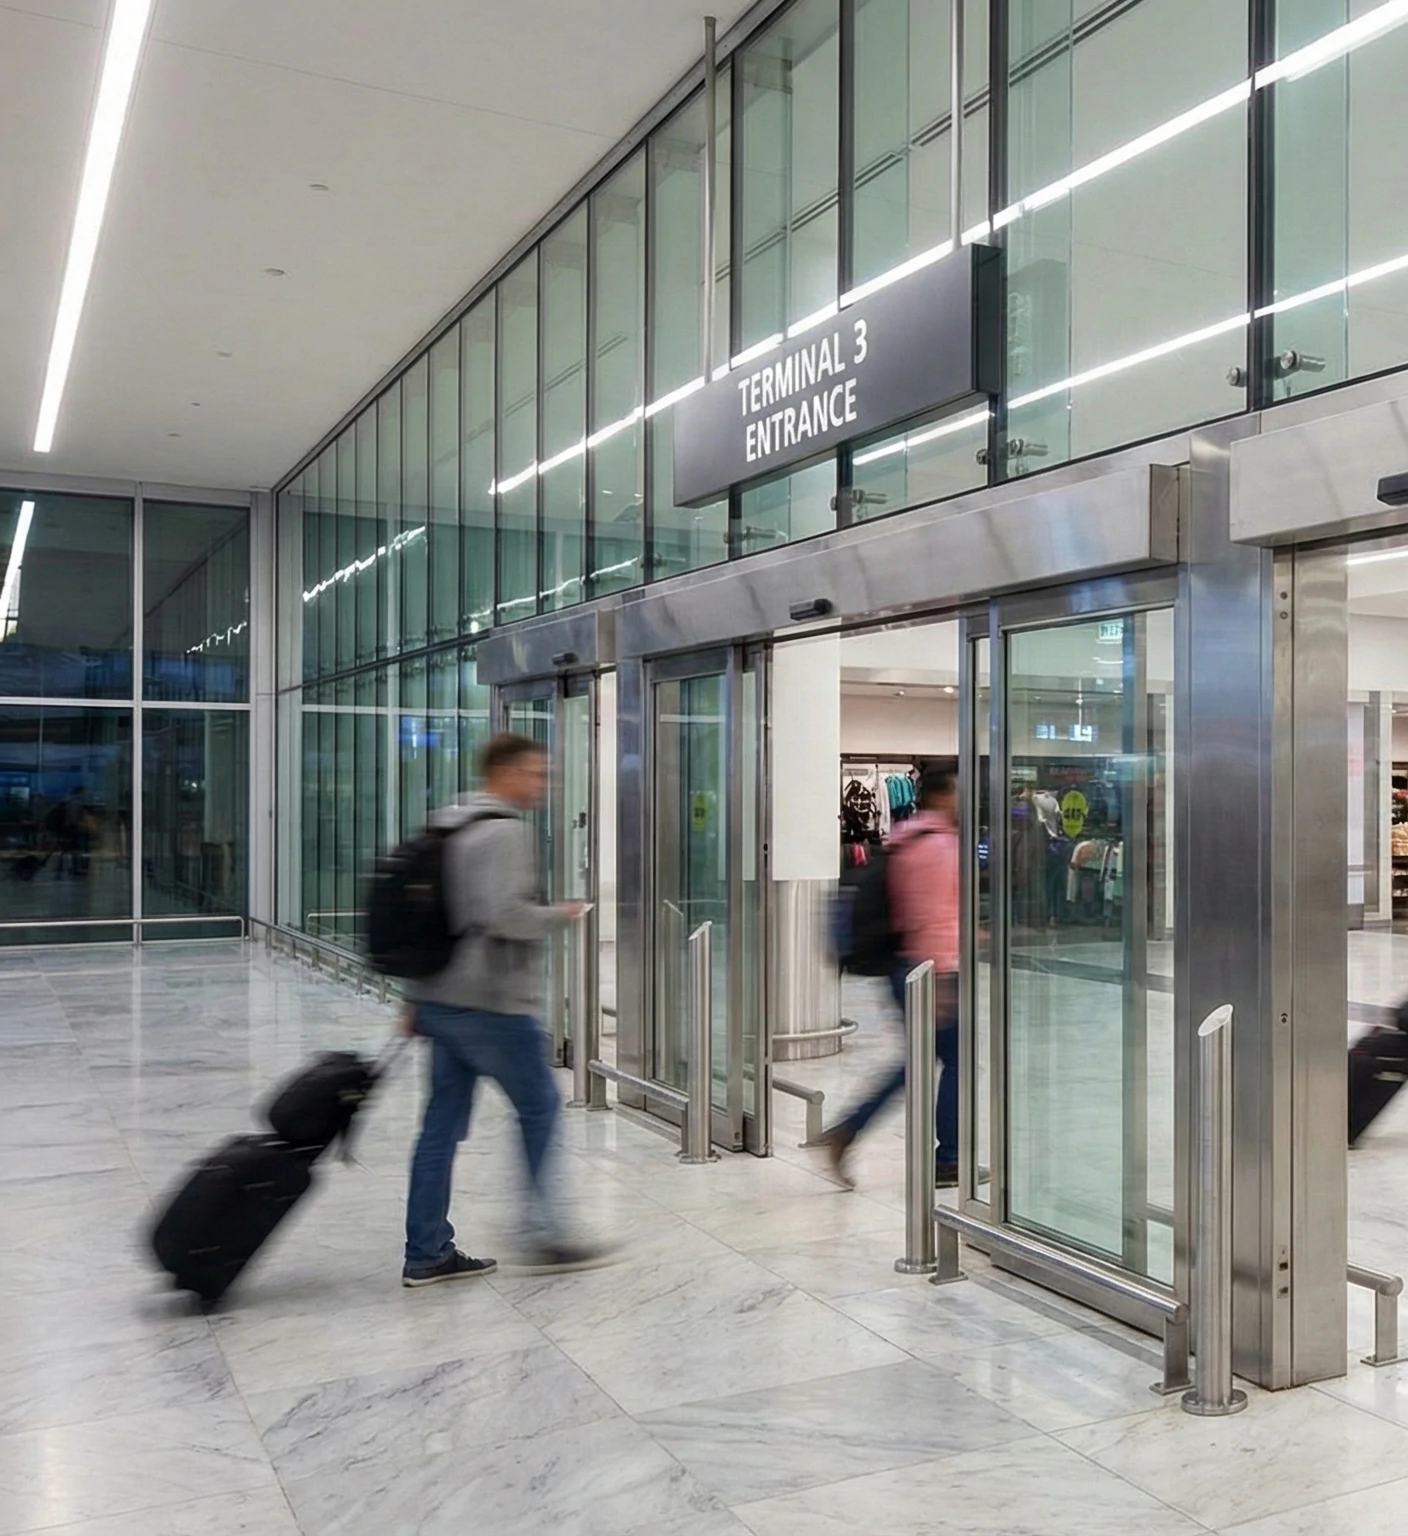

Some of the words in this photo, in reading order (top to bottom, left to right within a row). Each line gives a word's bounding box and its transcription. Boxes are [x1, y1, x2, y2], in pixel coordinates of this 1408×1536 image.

[737, 331, 846, 417] TERMINAL
[853, 318, 868, 365] 3
[746, 377, 858, 463] ENTRANCE
